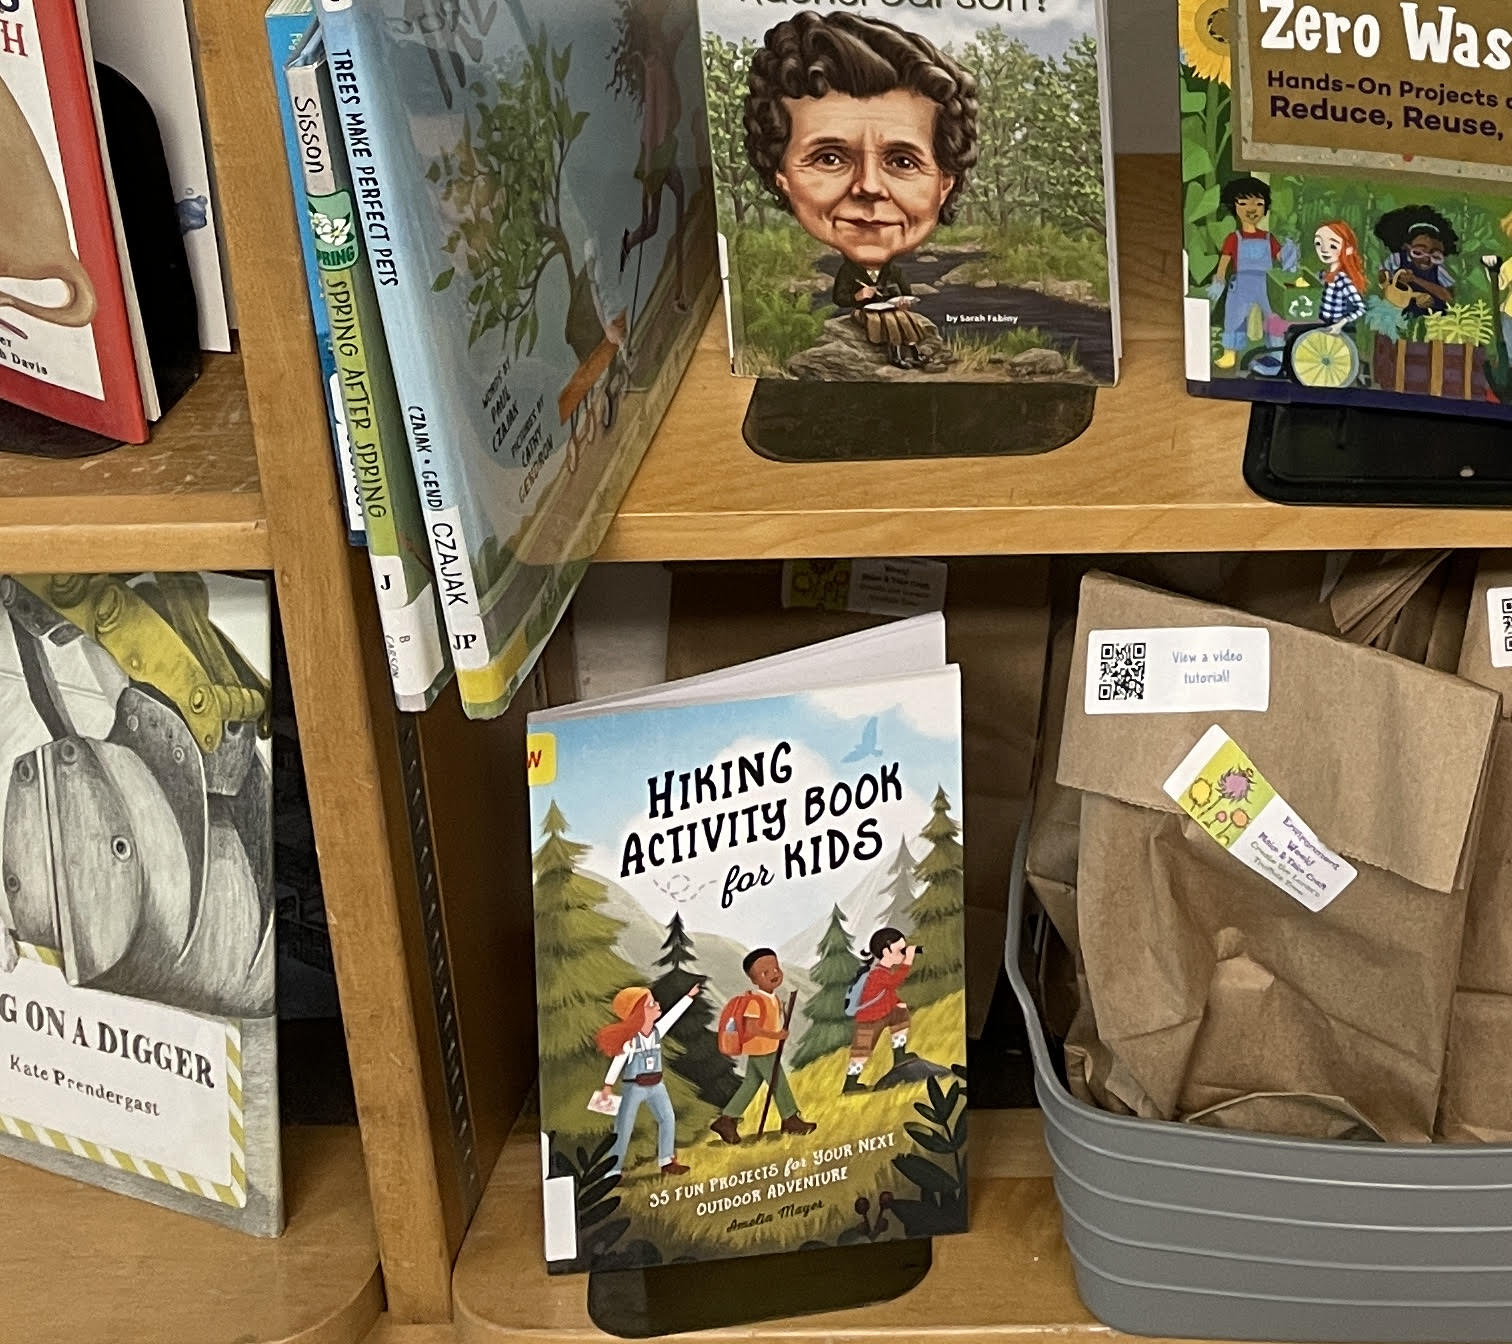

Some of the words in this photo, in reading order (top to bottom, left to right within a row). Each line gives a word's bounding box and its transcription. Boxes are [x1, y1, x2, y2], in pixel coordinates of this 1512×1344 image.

[332, 49, 360, 105] TREES
[294, 96, 324, 175] Sisson
[346, 113, 372, 158] MAKE
[1269, 96, 1394, 131] Reduce,
[1403, 106, 1504, 142] Reuse,
[356, 166, 390, 242] PERFECT
[373, 248, 398, 287] PETS
[325, 279, 357, 358] SPRING
[11, 352, 47, 375] Davis
[342, 367, 371, 431] AFTER
[353, 442, 386, 520] SPRING
[431, 523, 469, 606] CZAJAK
[453, 633, 477, 650] JP
[1172, 651, 1197, 663] View
[1213, 650, 1243, 662] video
[648, 741, 793, 819] HIKING
[620, 799, 786, 878] ACTIVITY
[805, 762, 902, 826] BOOK
[721, 864, 775, 908] for
[784, 818, 883, 880] KIDS
[26, 1001, 65, 1039] ON
[72, 1017, 90, 1048] A
[97, 1021, 215, 1088] DIGGER
[9, 1054, 50, 1083] Kate
[53, 1069, 160, 1118] Prendergast
[696, 1189, 761, 1217] OUTDOOR
[767, 1166, 848, 1201] ADVENTURE
